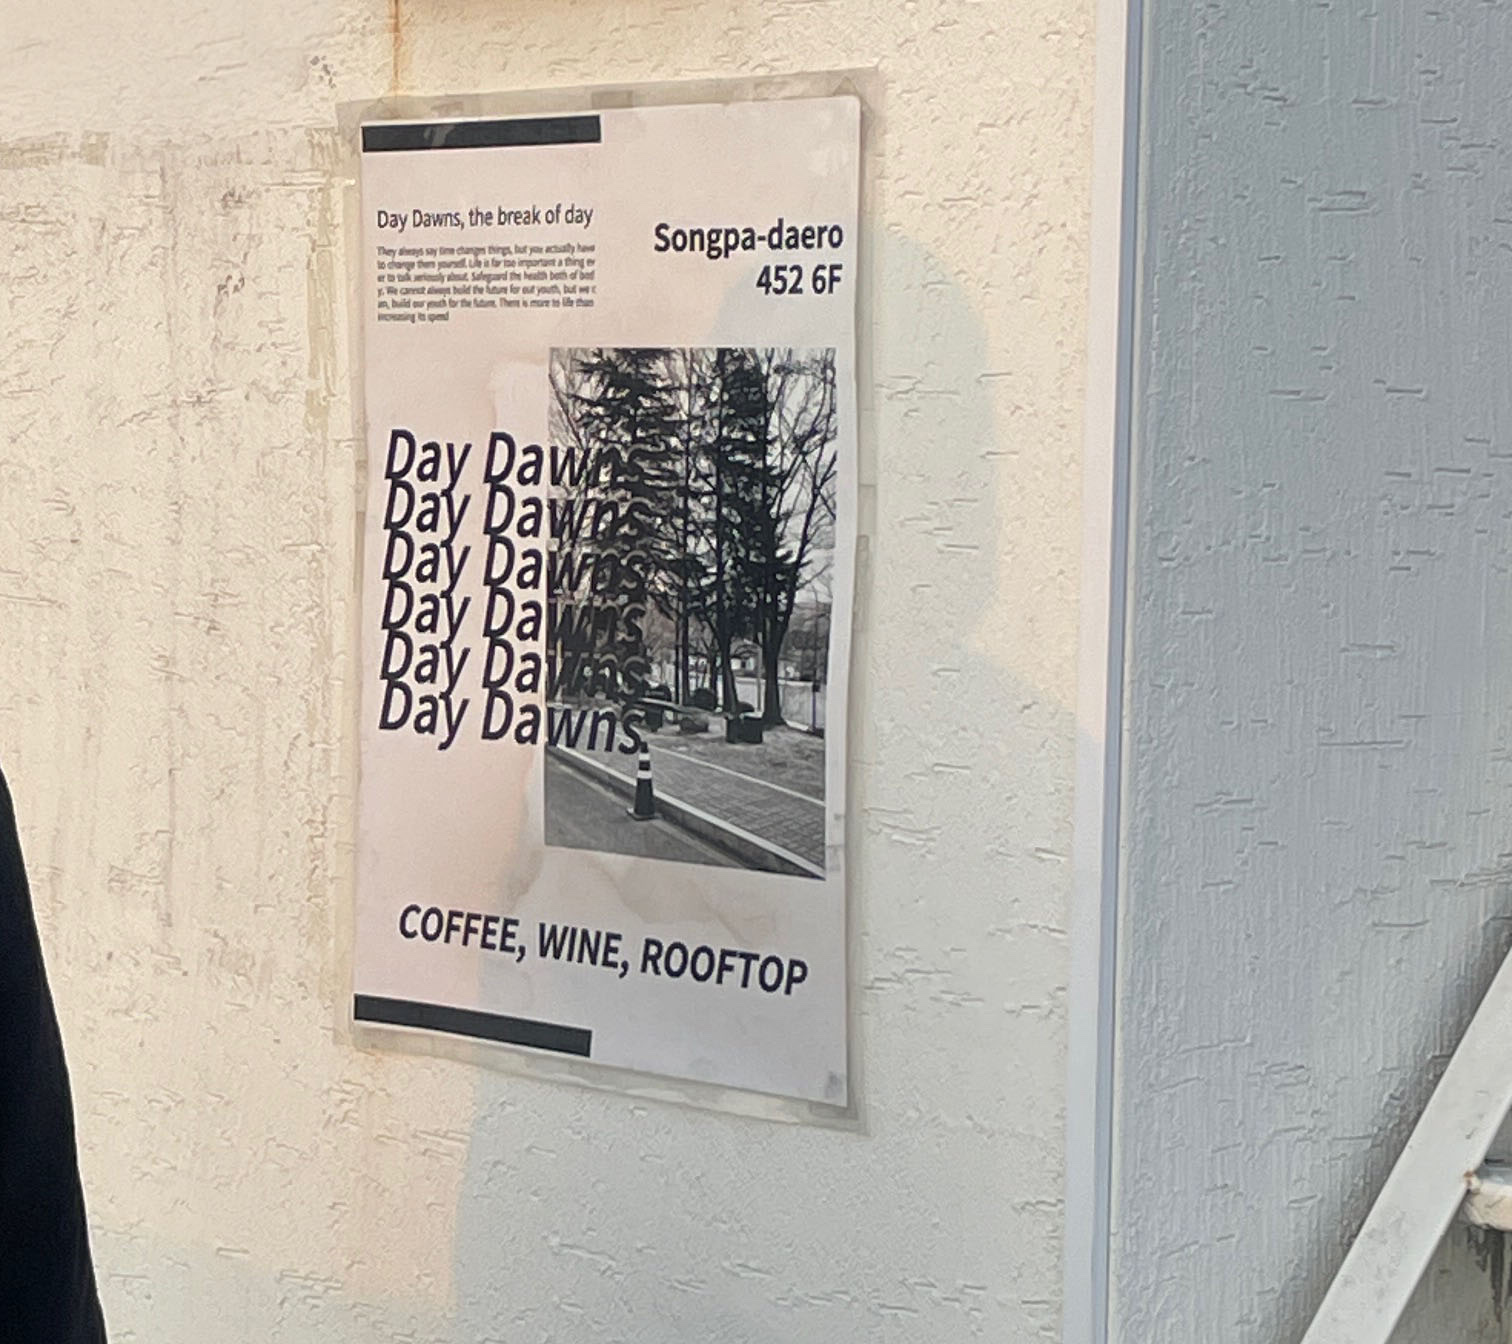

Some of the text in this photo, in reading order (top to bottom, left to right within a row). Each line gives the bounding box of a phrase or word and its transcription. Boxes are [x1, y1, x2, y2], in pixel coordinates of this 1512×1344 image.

[377, 203, 594, 233] Day Dawns, the break of day
[653, 217, 844, 260] Songpa-daero
[755, 263, 844, 296] 452 6F
[384, 429, 473, 498] Day
[383, 480, 472, 548] Day
[382, 530, 472, 599] Day
[381, 580, 472, 649] Day
[380, 630, 471, 699] Day
[378, 679, 646, 755] Day Dawns
[398, 903, 809, 997] COFFEE, WINE, ROOFTOP
